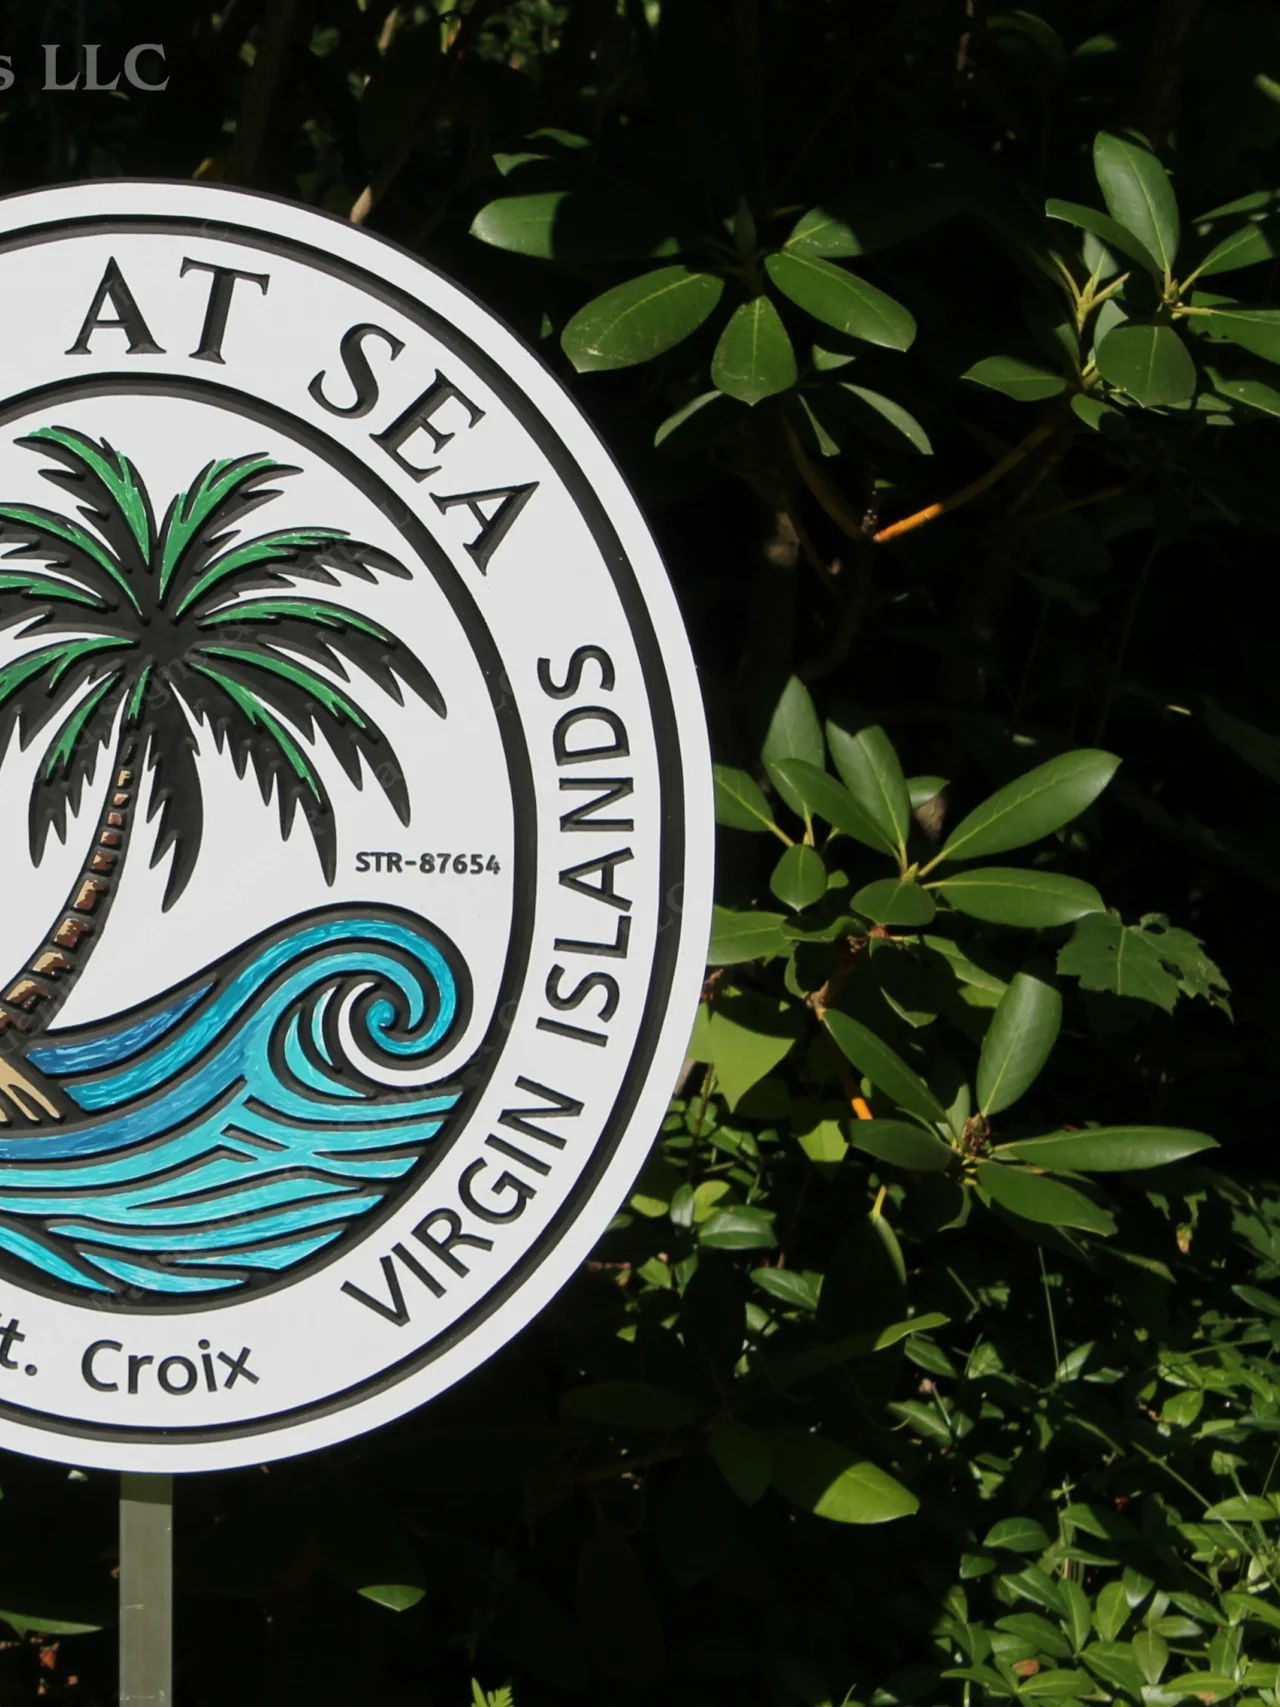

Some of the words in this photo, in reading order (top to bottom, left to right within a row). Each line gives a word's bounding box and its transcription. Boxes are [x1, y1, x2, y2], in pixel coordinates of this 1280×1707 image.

[65, 256, 271, 365] AT
[307, 322, 541, 577] SEA
[356, 852, 501, 875] STR-87654
[340, 1076, 586, 1328] VIRGIN
[536, 644, 636, 1048] ISLANDS
[82, 1338, 261, 1397] Croix
